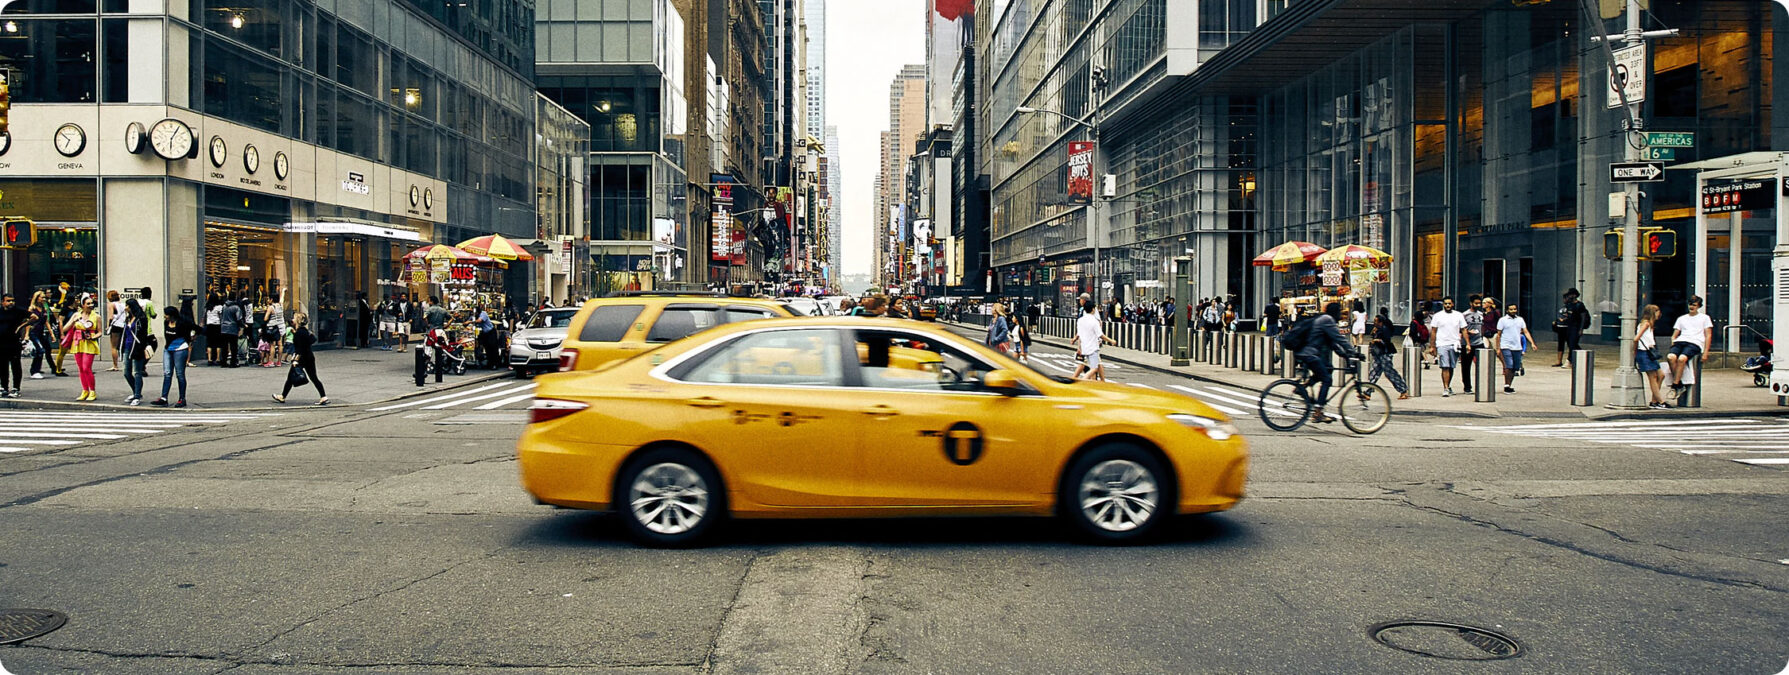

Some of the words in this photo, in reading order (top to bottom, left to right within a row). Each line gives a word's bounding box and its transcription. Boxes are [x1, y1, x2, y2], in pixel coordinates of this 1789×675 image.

[1632, 49, 1643, 57] AREA
[1630, 80, 1643, 90] OVER
[1650, 137, 1693, 146] AMERICAS
[1652, 148, 1660, 159] 6
[1068, 152, 1092, 166] JERSEY
[1071, 164, 1088, 177] BOYS
[1617, 168, 1634, 177] ONE
[1639, 167, 1656, 176] WAY
[1743, 182, 1762, 190] Station
[1704, 197, 1710, 205] B
[1713, 196, 1719, 204] D
[1723, 194, 1728, 203] F
[1732, 193, 1739, 202] M
